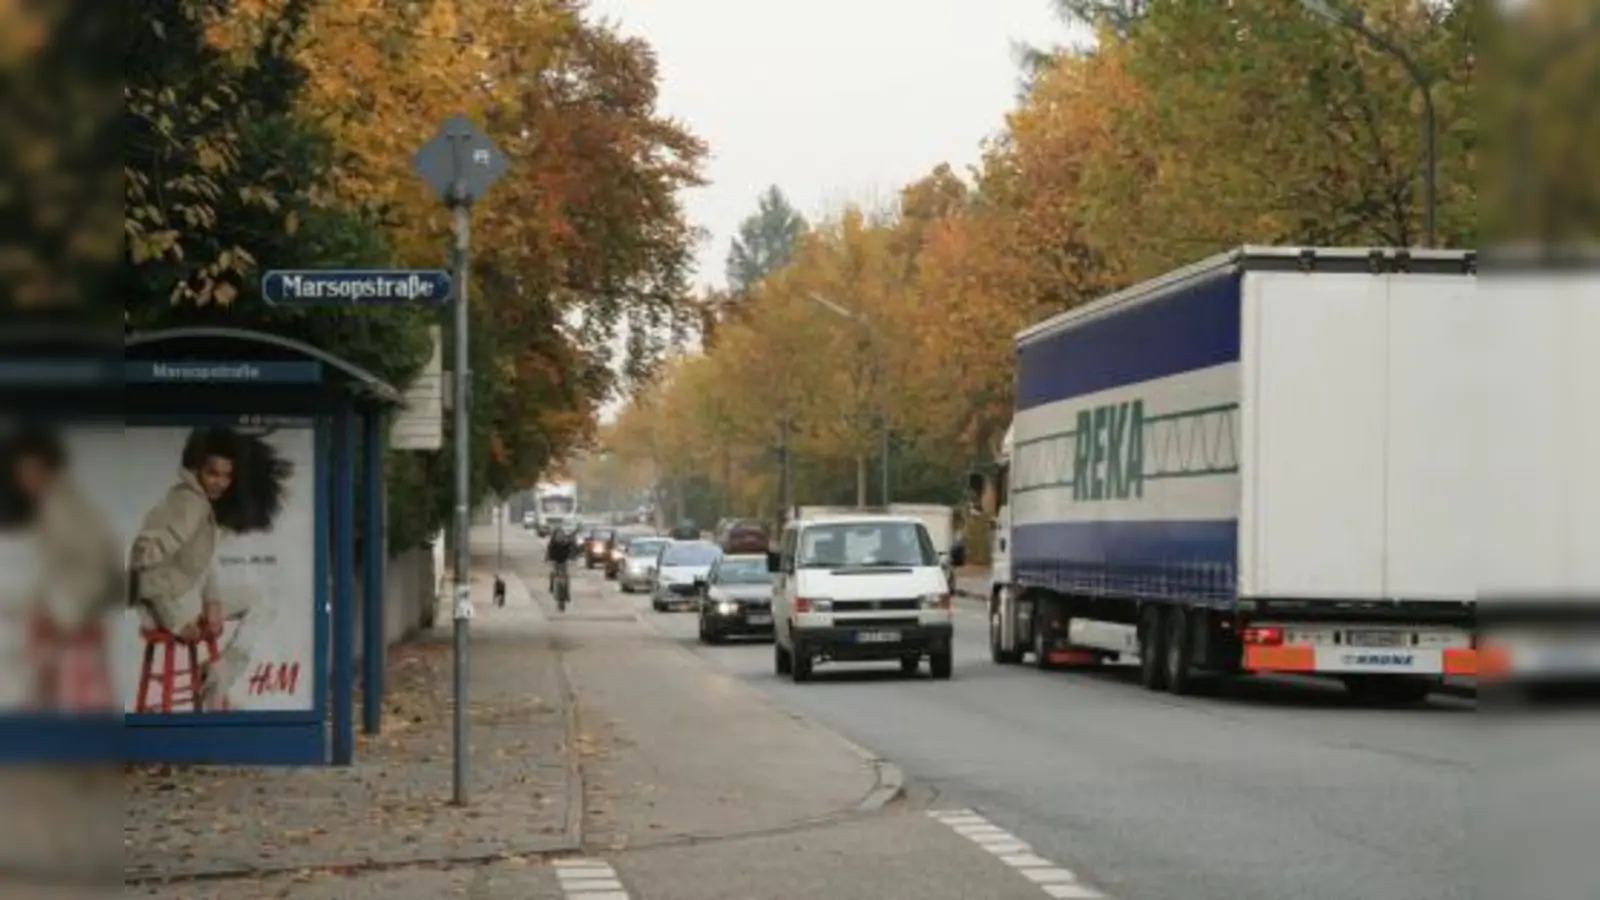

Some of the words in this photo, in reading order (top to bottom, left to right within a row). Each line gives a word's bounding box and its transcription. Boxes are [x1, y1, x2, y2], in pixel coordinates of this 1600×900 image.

[281, 275, 434, 300] Marsopstraße
[1073, 398, 1144, 501] REKA
[249, 662, 301, 696] H&M
